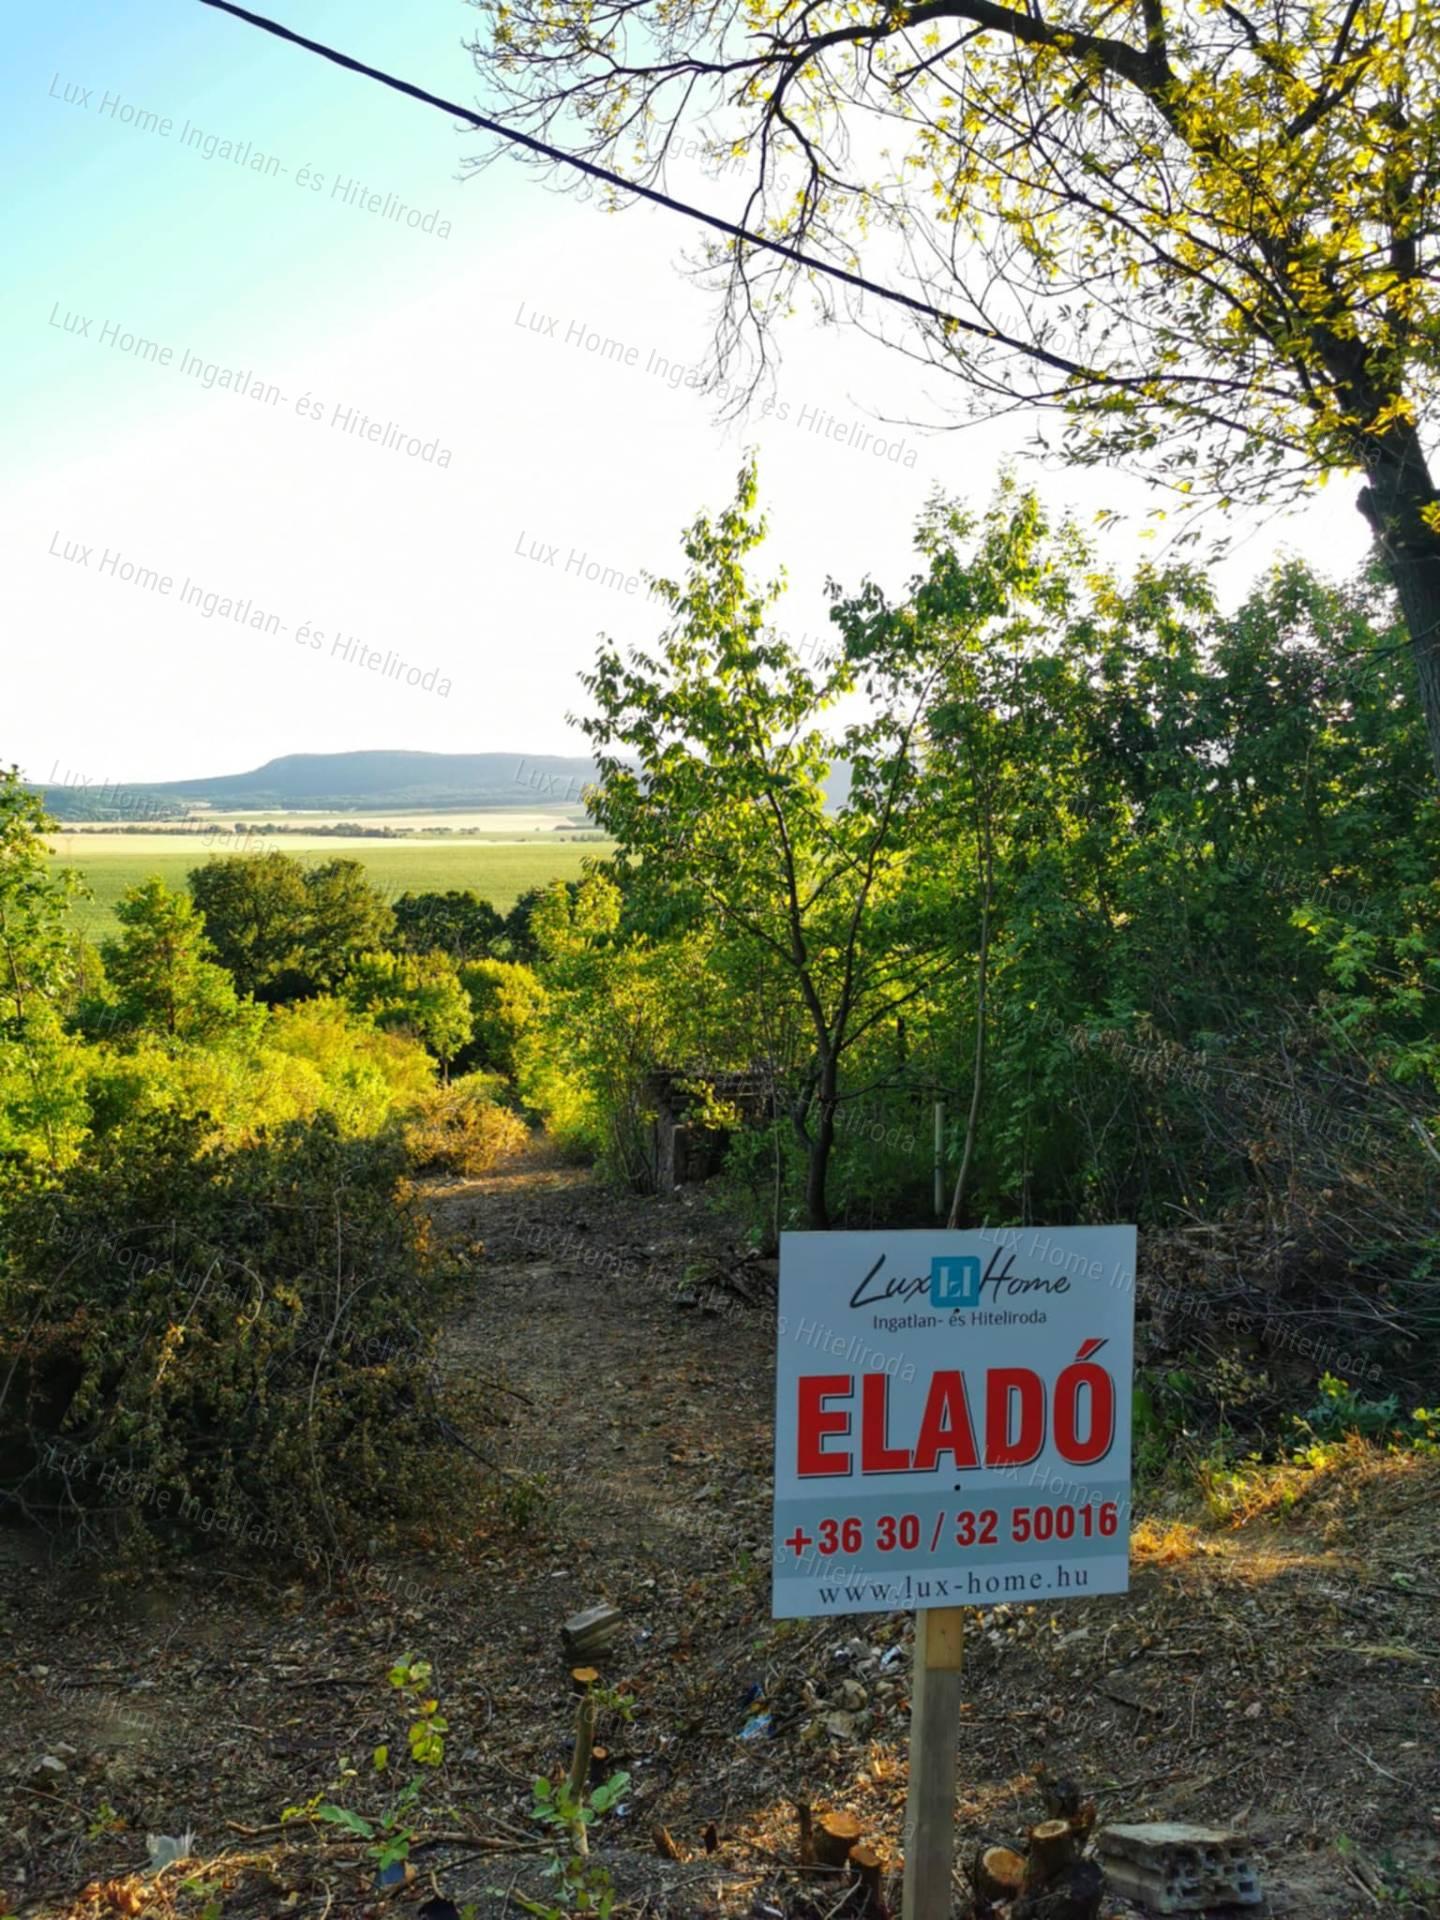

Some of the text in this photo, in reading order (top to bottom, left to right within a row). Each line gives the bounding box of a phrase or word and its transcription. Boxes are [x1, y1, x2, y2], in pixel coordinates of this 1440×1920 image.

[849, 1246, 1071, 1308] Lux Home
[873, 1314, 943, 1333] Ingatlan-
[971, 1309, 1048, 1327] Hiteliroda
[797, 1338, 1116, 1478] ELADÓ
[785, 1517, 863, 1557] +36
[876, 1514, 920, 1551] 30
[930, 1511, 945, 1552] /
[956, 1509, 998, 1547] 32
[1012, 1502, 1118, 1543] 50016
[818, 1565, 1089, 1605] www.lux-home.hu
